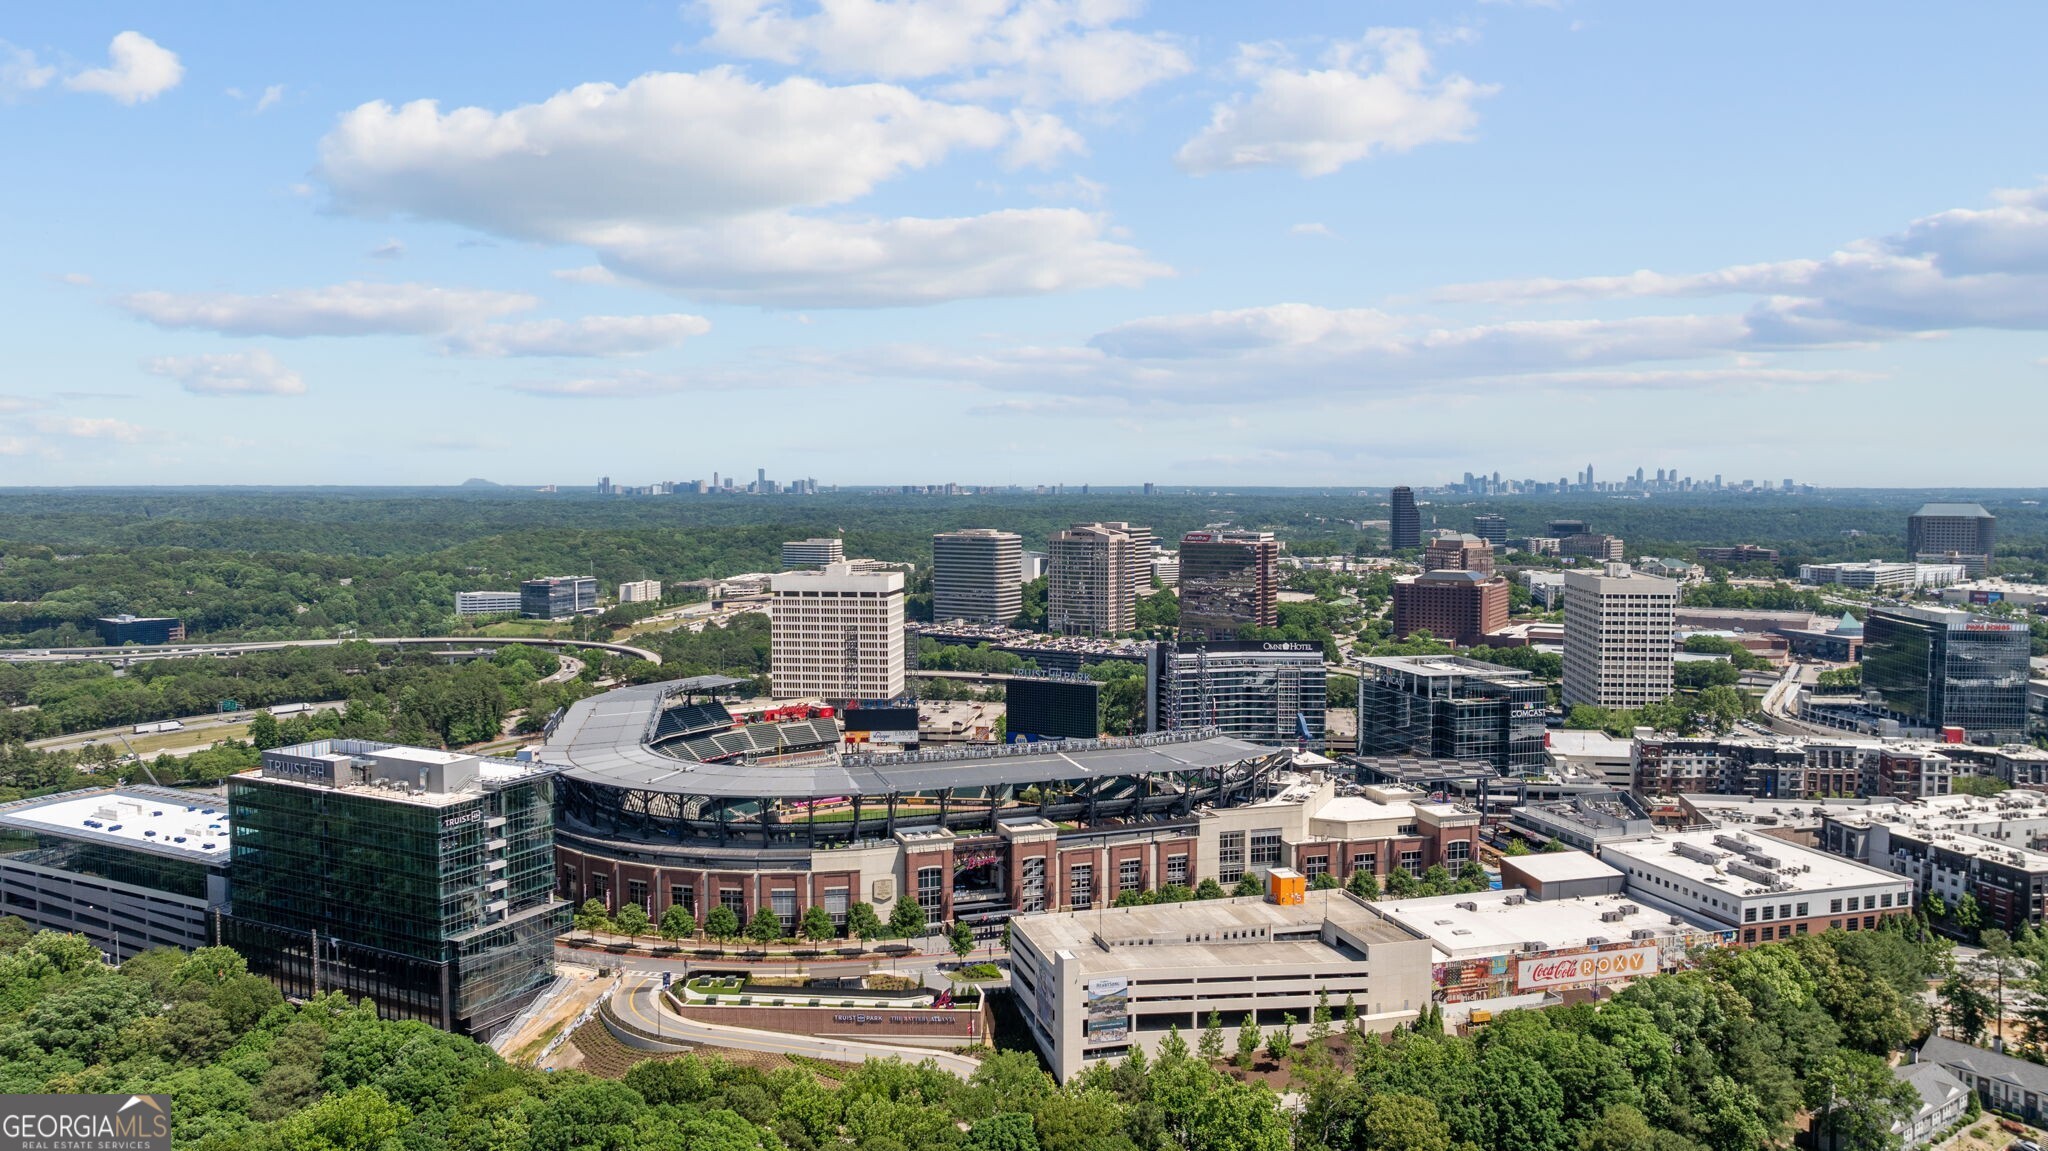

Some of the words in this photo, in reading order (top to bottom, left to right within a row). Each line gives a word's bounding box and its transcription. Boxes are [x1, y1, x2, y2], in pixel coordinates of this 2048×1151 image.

[1290, 642, 1313, 650] HOTEL
[1012, 667, 1047, 678] TRUIST
[1064, 671, 1091, 681] PARK
[1511, 709, 1546, 717] COMCAST
[267, 759, 307, 776] TRUIST
[445, 814, 471, 827] TRUIST
[1532, 959, 1578, 982] Coca-Cola
[1582, 954, 1643, 975] ROXY
[930, 1015, 956, 1023] ATLANTA
